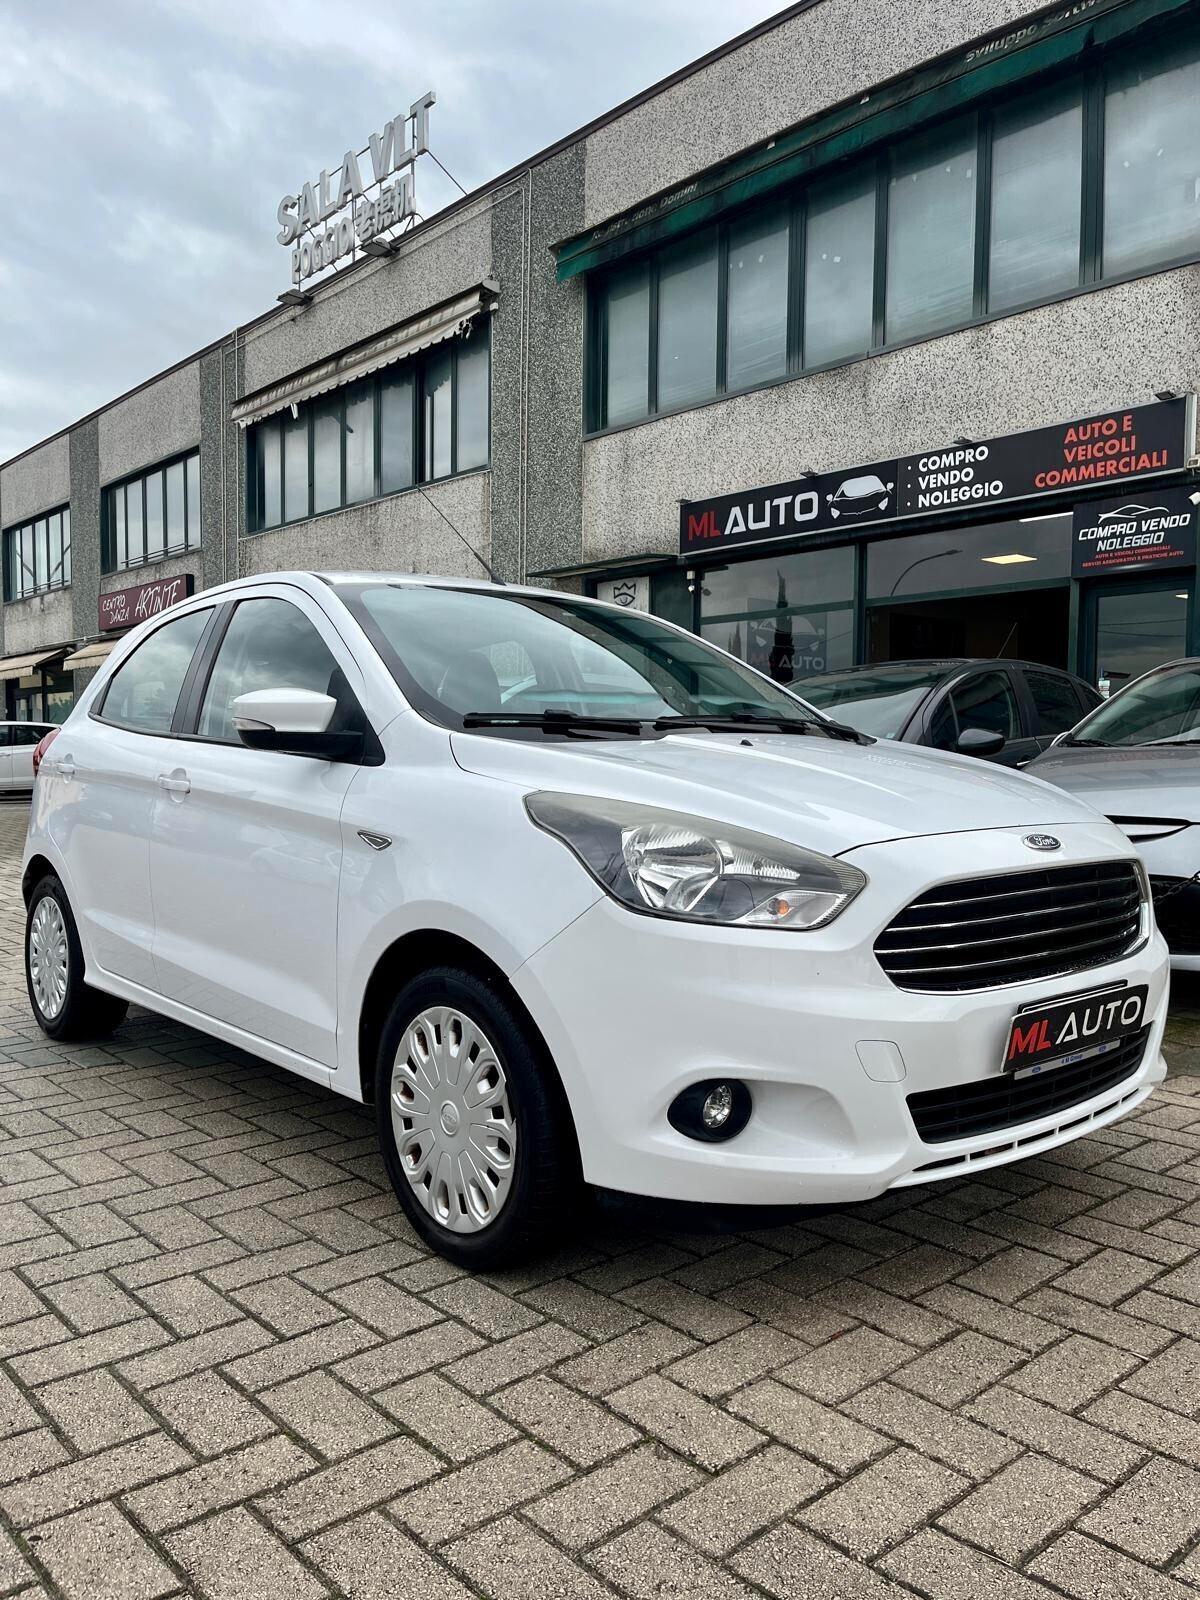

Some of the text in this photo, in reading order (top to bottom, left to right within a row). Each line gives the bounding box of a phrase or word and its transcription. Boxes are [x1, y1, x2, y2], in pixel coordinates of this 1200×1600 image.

[276, 91, 436, 246] SALA VLT
[291, 216, 353, 285] POGGIO
[1063, 415, 1133, 445] AUTO E
[918, 445, 989, 473] COMPRO
[1063, 435, 1136, 464] VEICOLI
[918, 467, 974, 491] VENDO
[1034, 450, 1168, 489] COMMERCIALI
[918, 480, 1004, 508] NOLEGGIO
[688, 491, 819, 541] ML AUTO
[1078, 513, 1191, 541] COMPRO VENDO
[1096, 531, 1165, 552] NOLEGGIO
[102, 594, 126, 612] CENTRO
[109, 606, 130, 625] DANZA
[778, 654, 825, 671] AUTO
[1008, 995, 1142, 1061] ML AUTO
